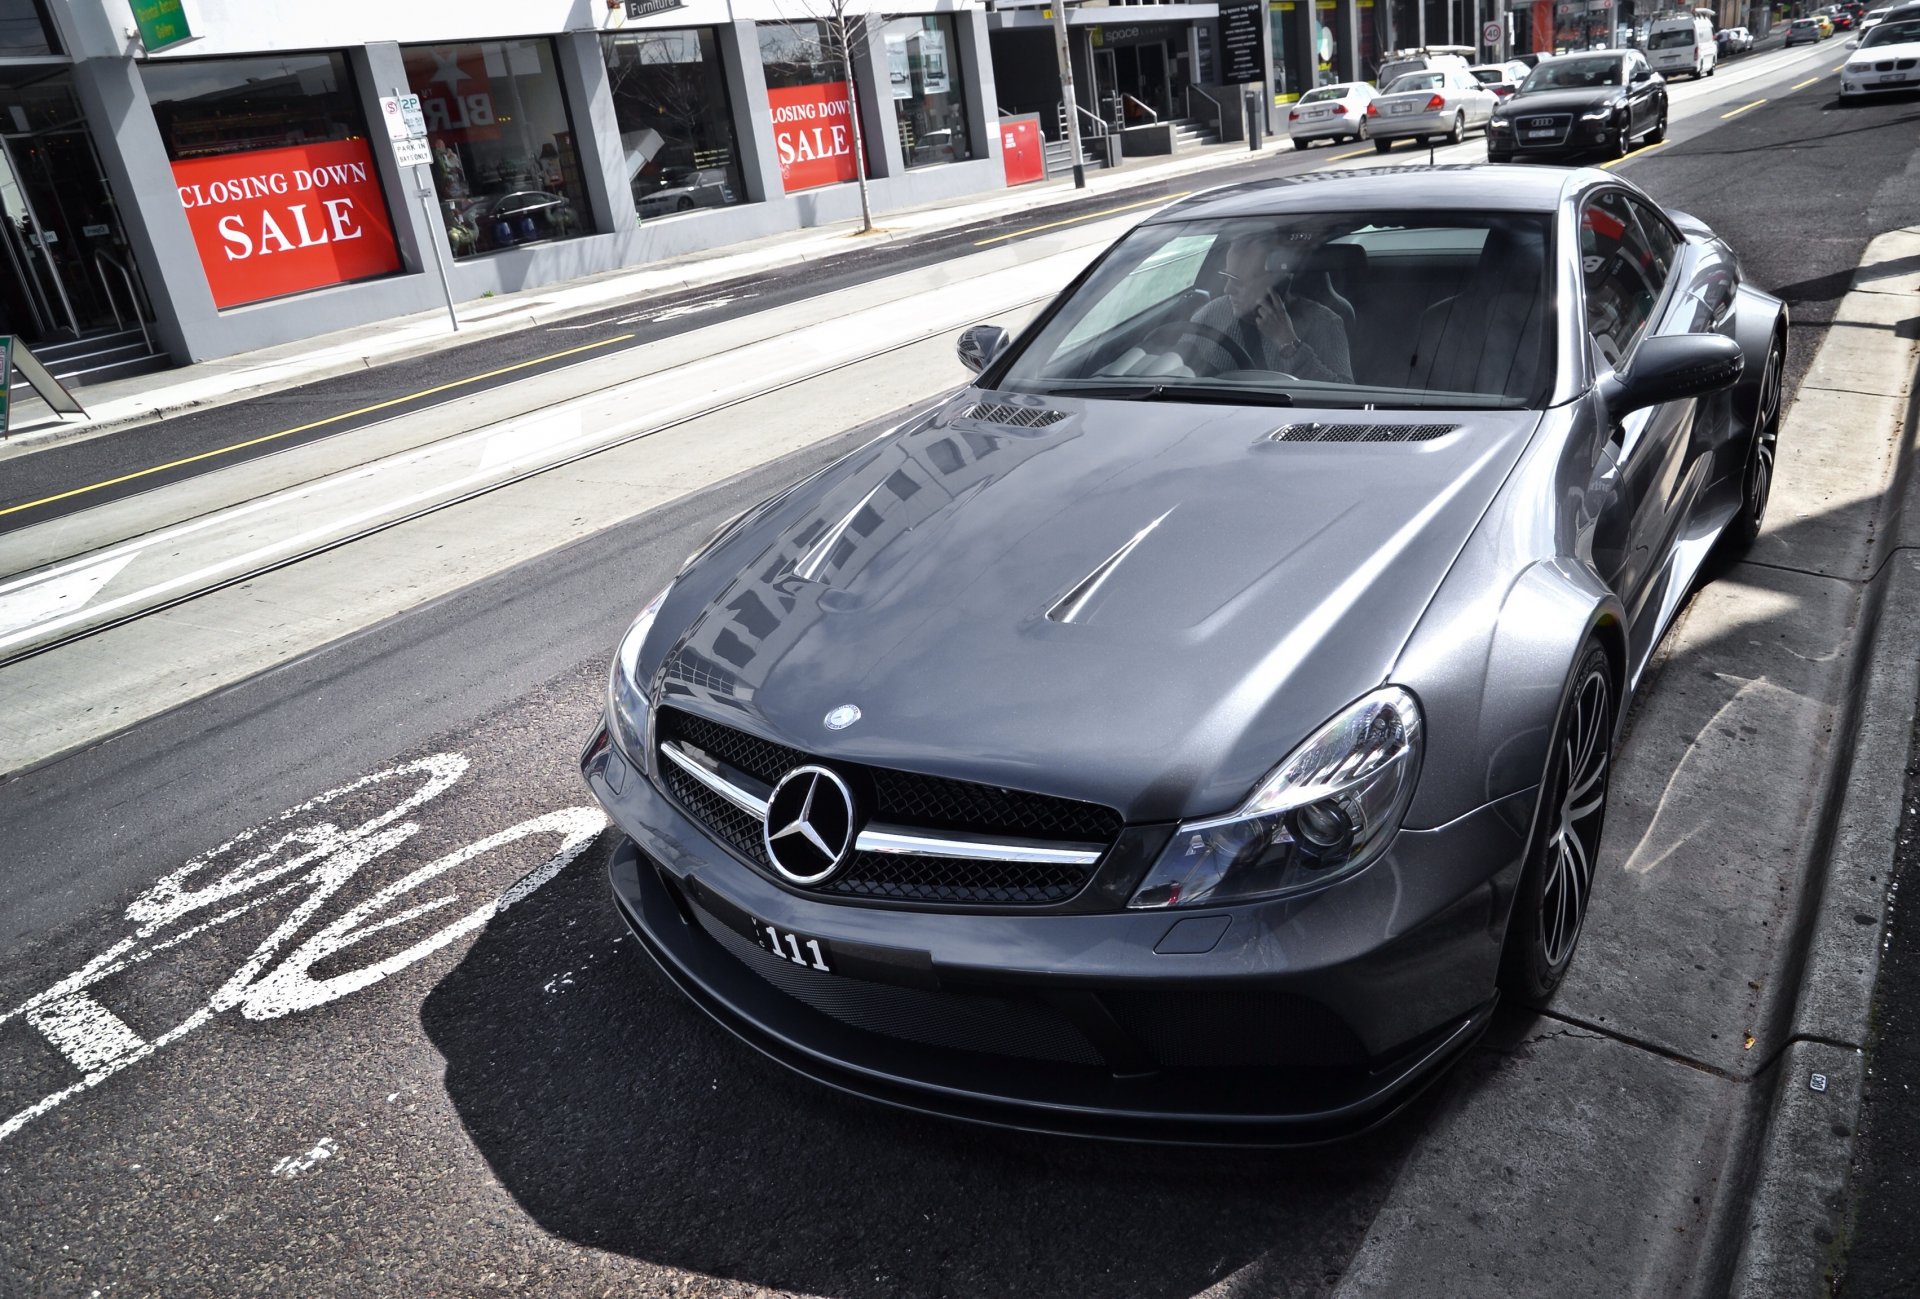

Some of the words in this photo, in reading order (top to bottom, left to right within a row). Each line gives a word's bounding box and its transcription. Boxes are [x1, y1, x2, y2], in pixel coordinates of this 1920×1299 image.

[631, 0, 675, 16] Furniture
[1105, 27, 1139, 43] space
[1487, 29, 1499, 38] 40
[401, 98, 417, 110] 2P
[769, 103, 816, 124] LOSING
[397, 144, 415, 152] PARK
[777, 125, 850, 165] SALE
[414, 153, 428, 161] ONLY
[177, 173, 288, 208] CLOSING
[293, 162, 367, 192] DOWN
[218, 198, 362, 261] SALE
[765, 926, 830, 972] 111
